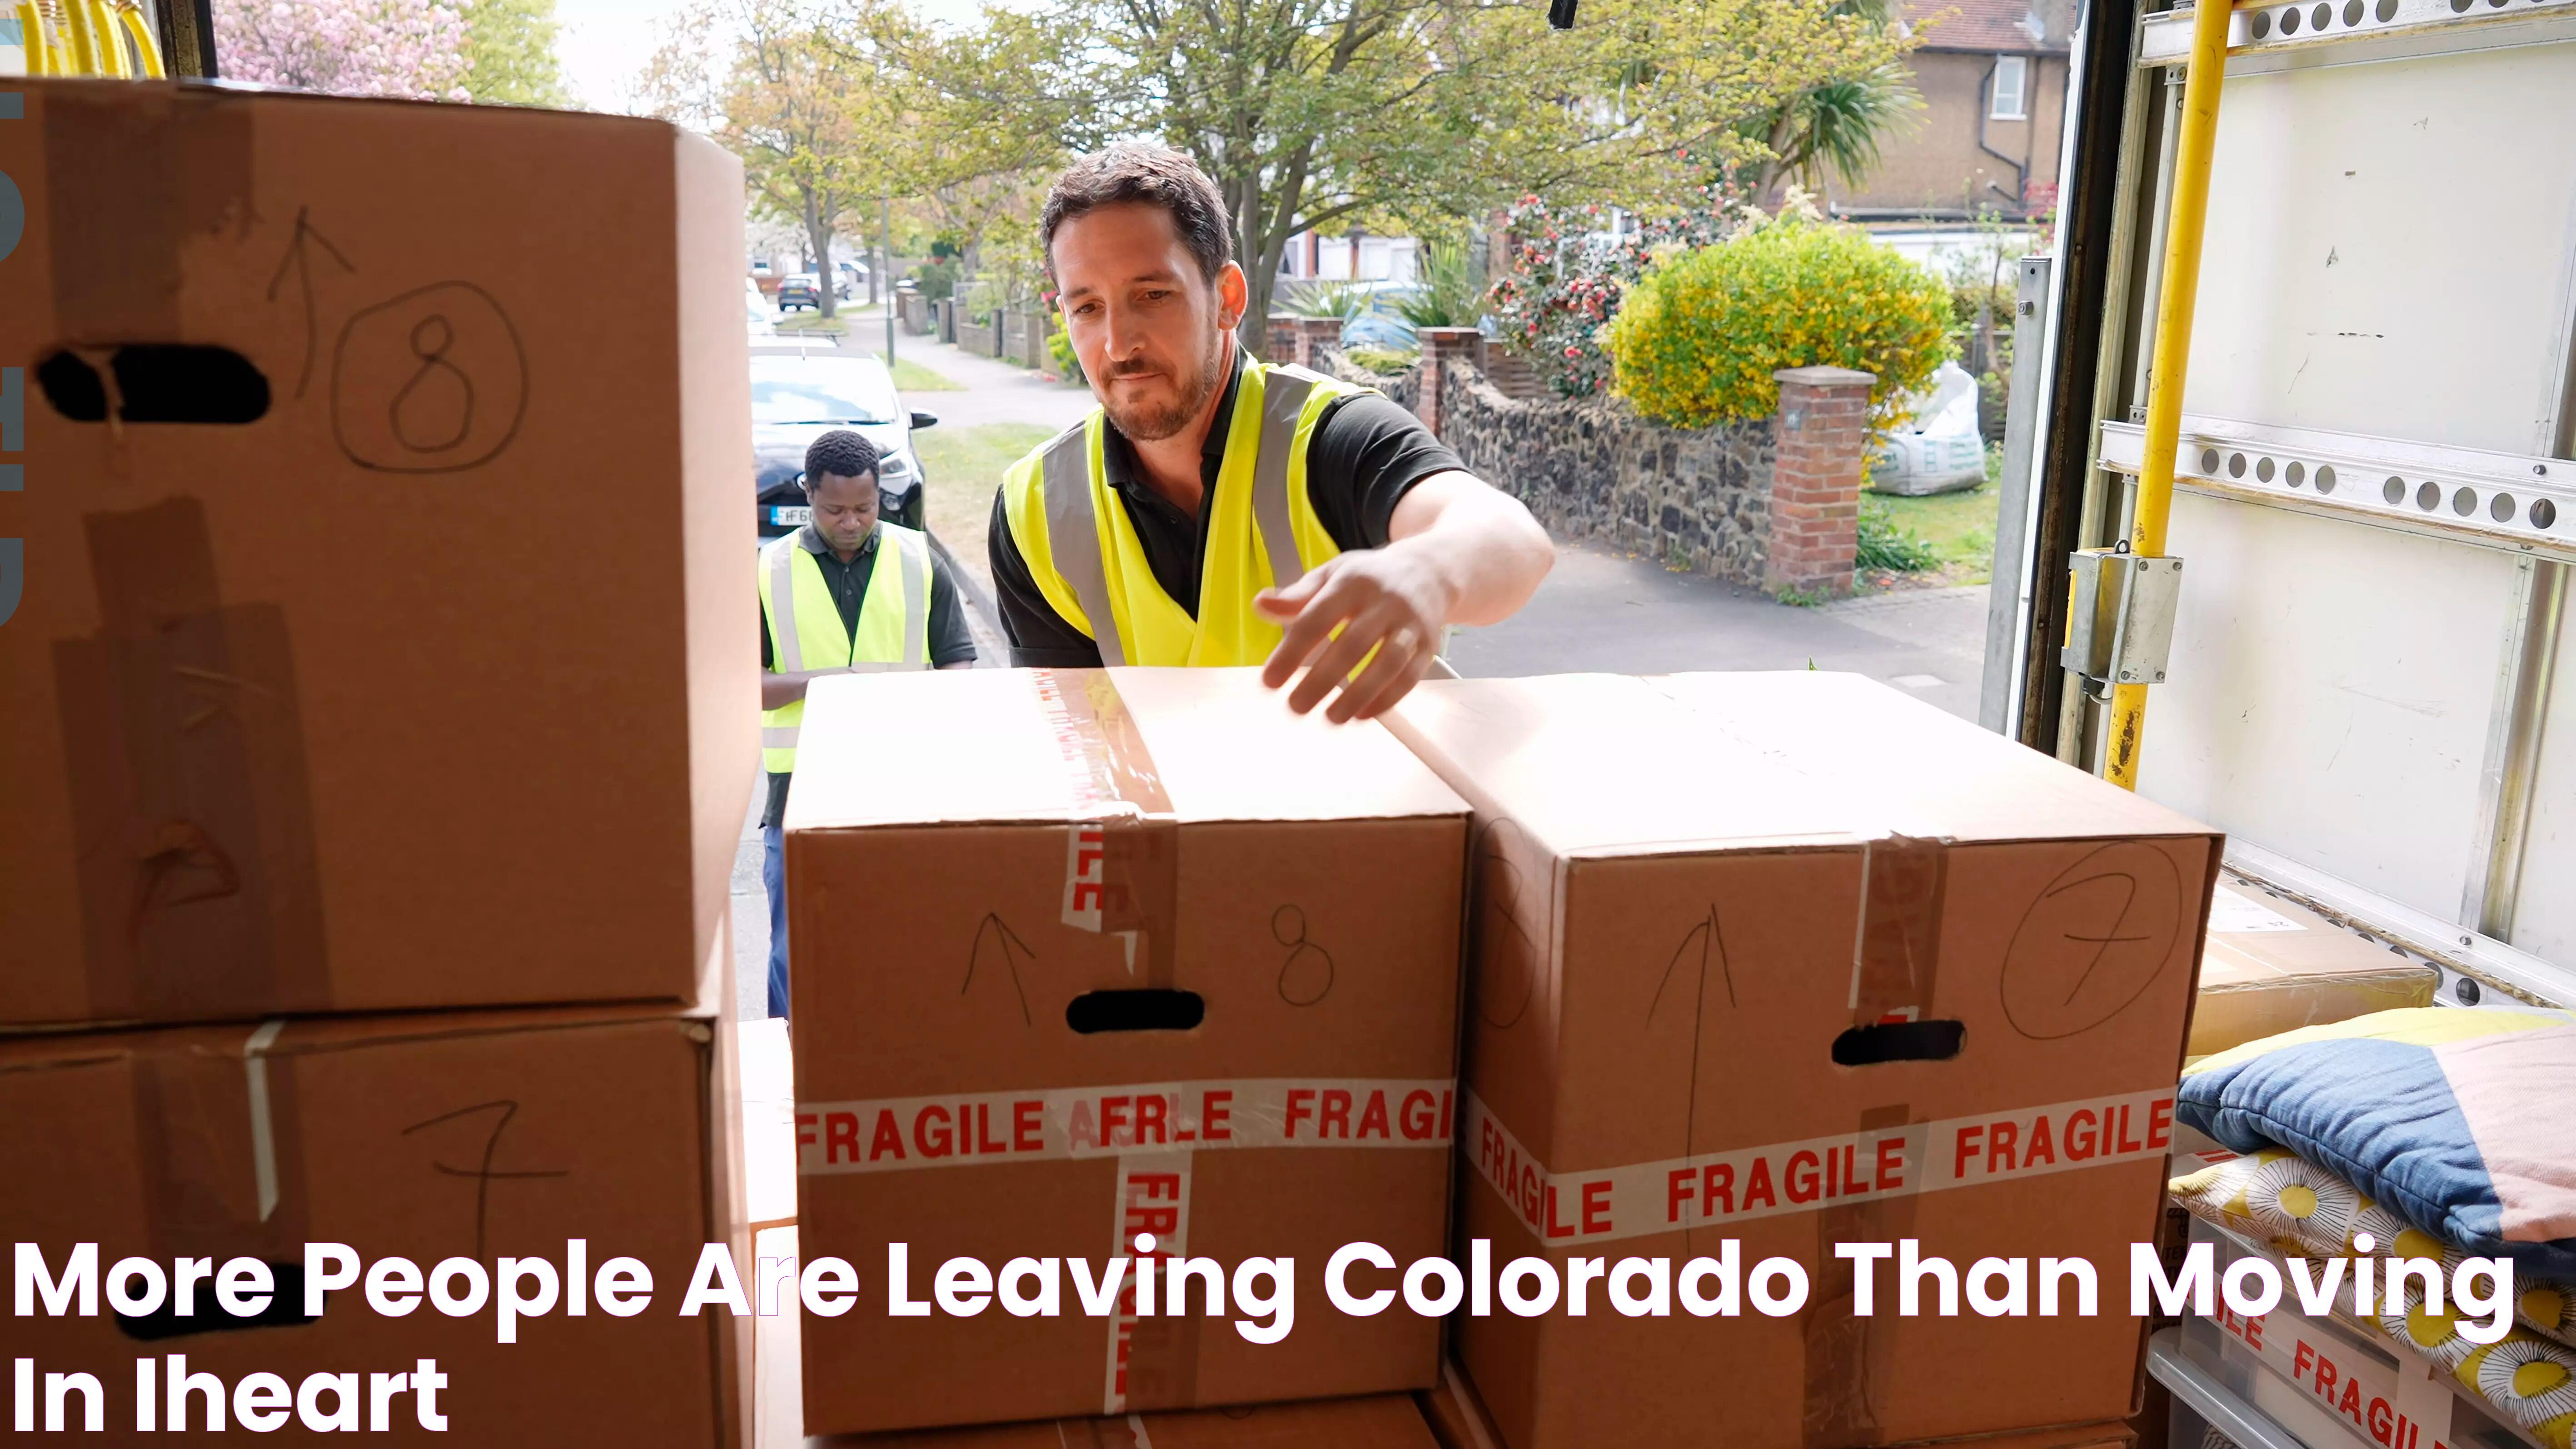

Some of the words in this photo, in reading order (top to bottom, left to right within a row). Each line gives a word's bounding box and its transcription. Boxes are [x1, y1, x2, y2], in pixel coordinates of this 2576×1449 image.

[389, 313, 474, 454] 8
[1271, 904, 1335, 1007] 8
[2045, 872, 2151, 1006] 7
[402, 1100, 570, 1261] 7
[796, 1102, 1044, 1166] FRAGILE
[1285, 1089, 1453, 1141] FRAGI
[1669, 1137, 1906, 1222] FRAGILE
[1955, 1099, 2173, 1178] FRAGILE
[2293, 1339, 2448, 1449] FRAGIL
